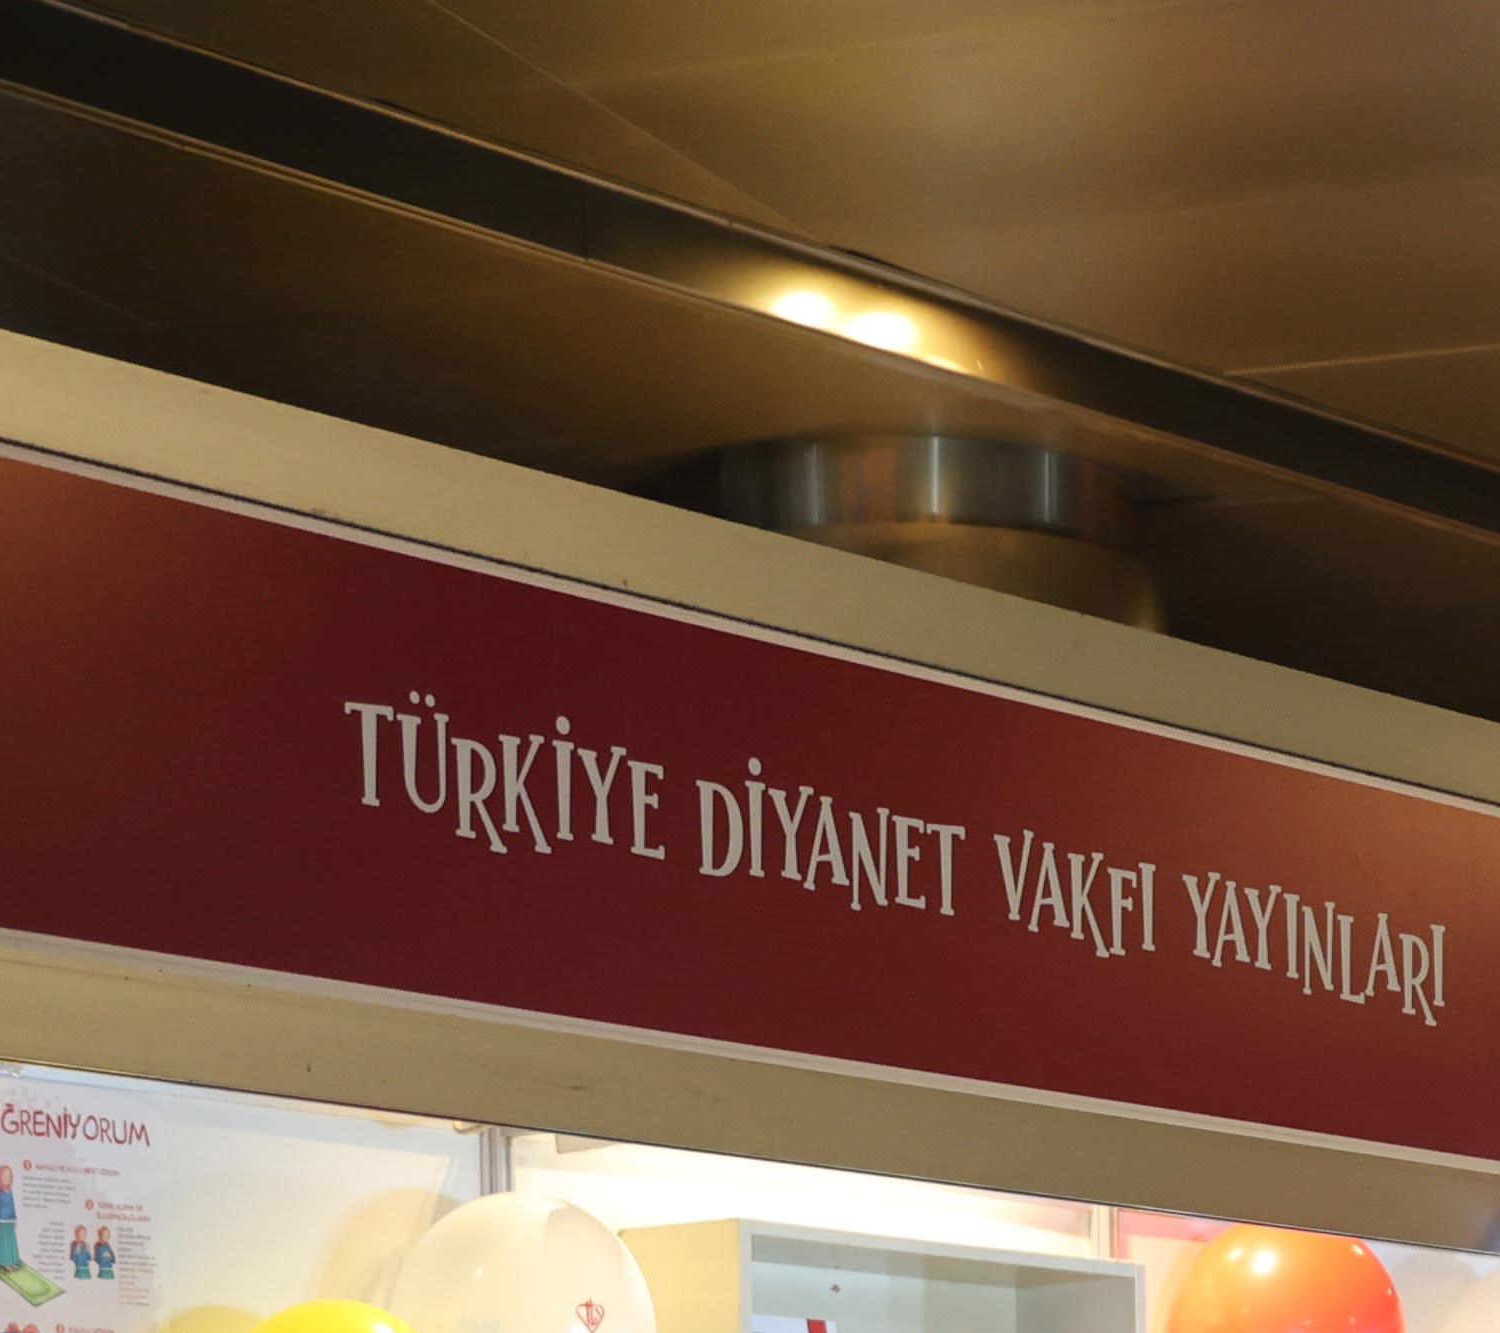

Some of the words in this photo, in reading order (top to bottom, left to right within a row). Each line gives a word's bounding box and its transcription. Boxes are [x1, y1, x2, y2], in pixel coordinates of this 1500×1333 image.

[345, 691, 665, 860] TÜRKİYE
[697, 757, 965, 915] DİYANET
[993, 830, 1156, 958] VAKFI
[1182, 872, 1446, 1026] YAYINLARI
